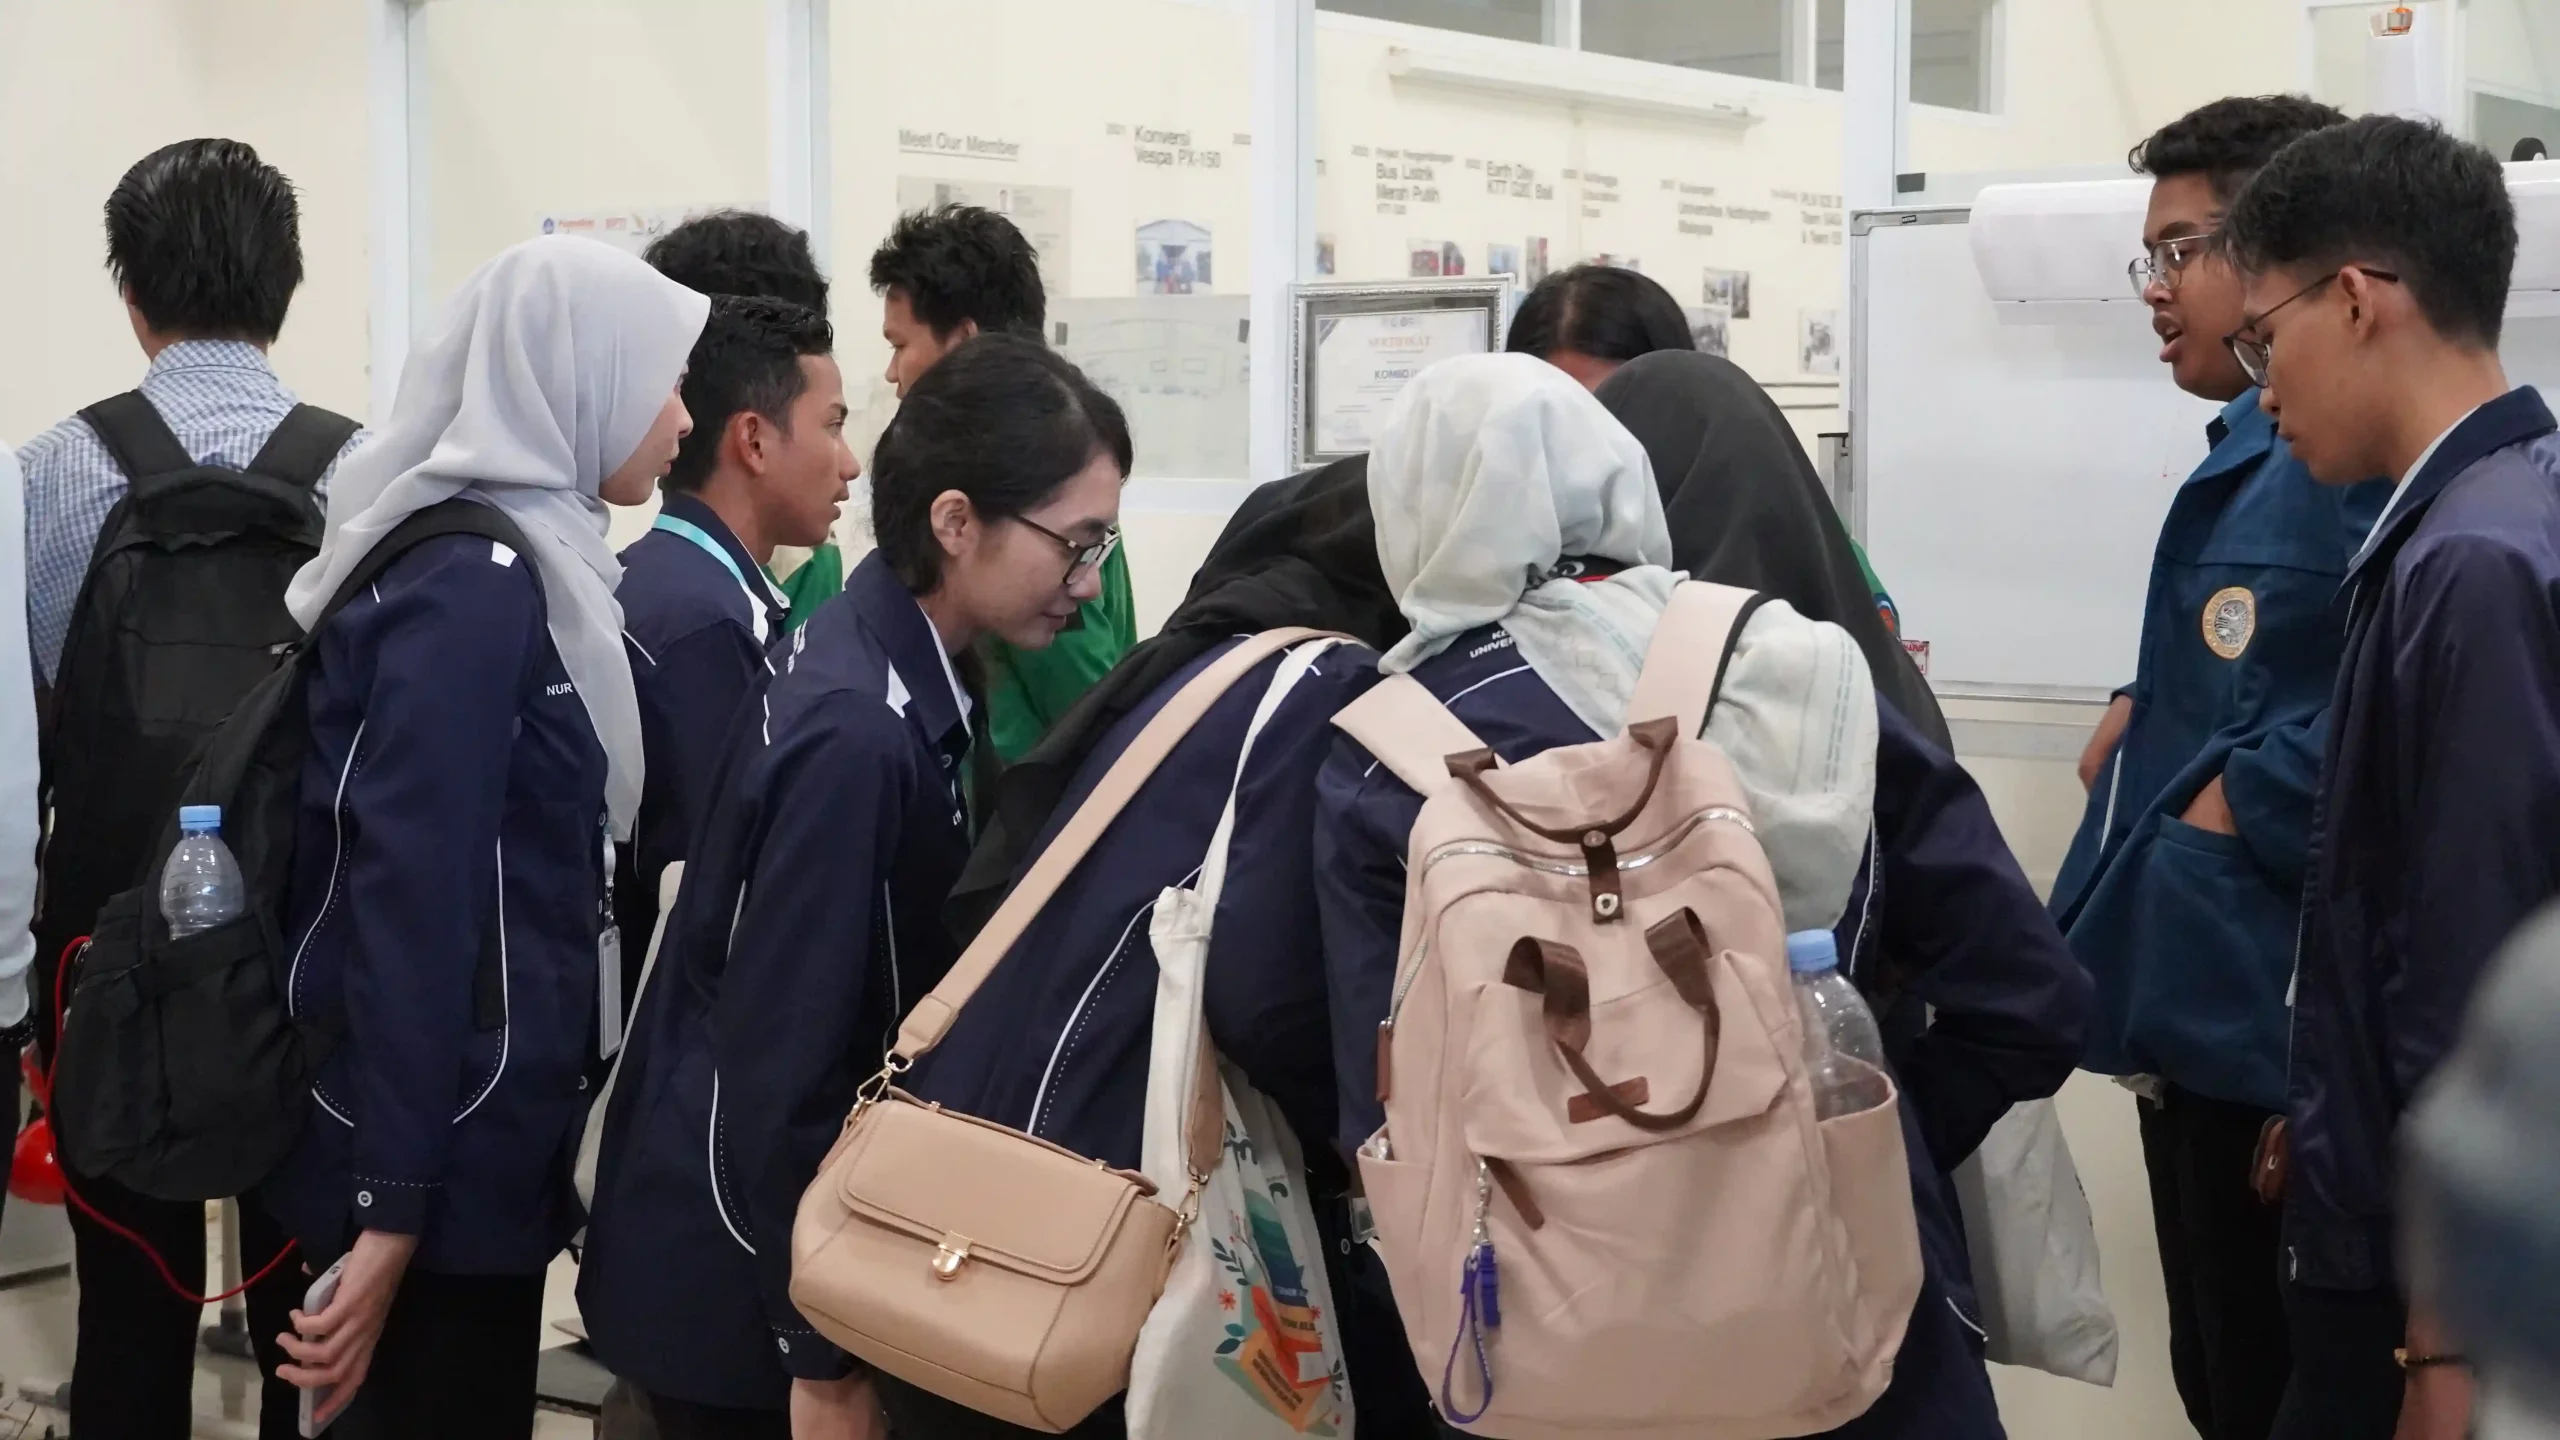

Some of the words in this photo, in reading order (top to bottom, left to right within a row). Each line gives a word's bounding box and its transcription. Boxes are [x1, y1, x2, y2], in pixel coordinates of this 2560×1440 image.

[936, 132, 961, 149] Our
[966, 135, 1019, 155] Member
[1135, 147, 1173, 168] Vespa
[1376, 163, 1397, 180] Bus
[1368, 335, 1433, 348] SERTIFIKAT
[546, 682, 574, 696] NUR
